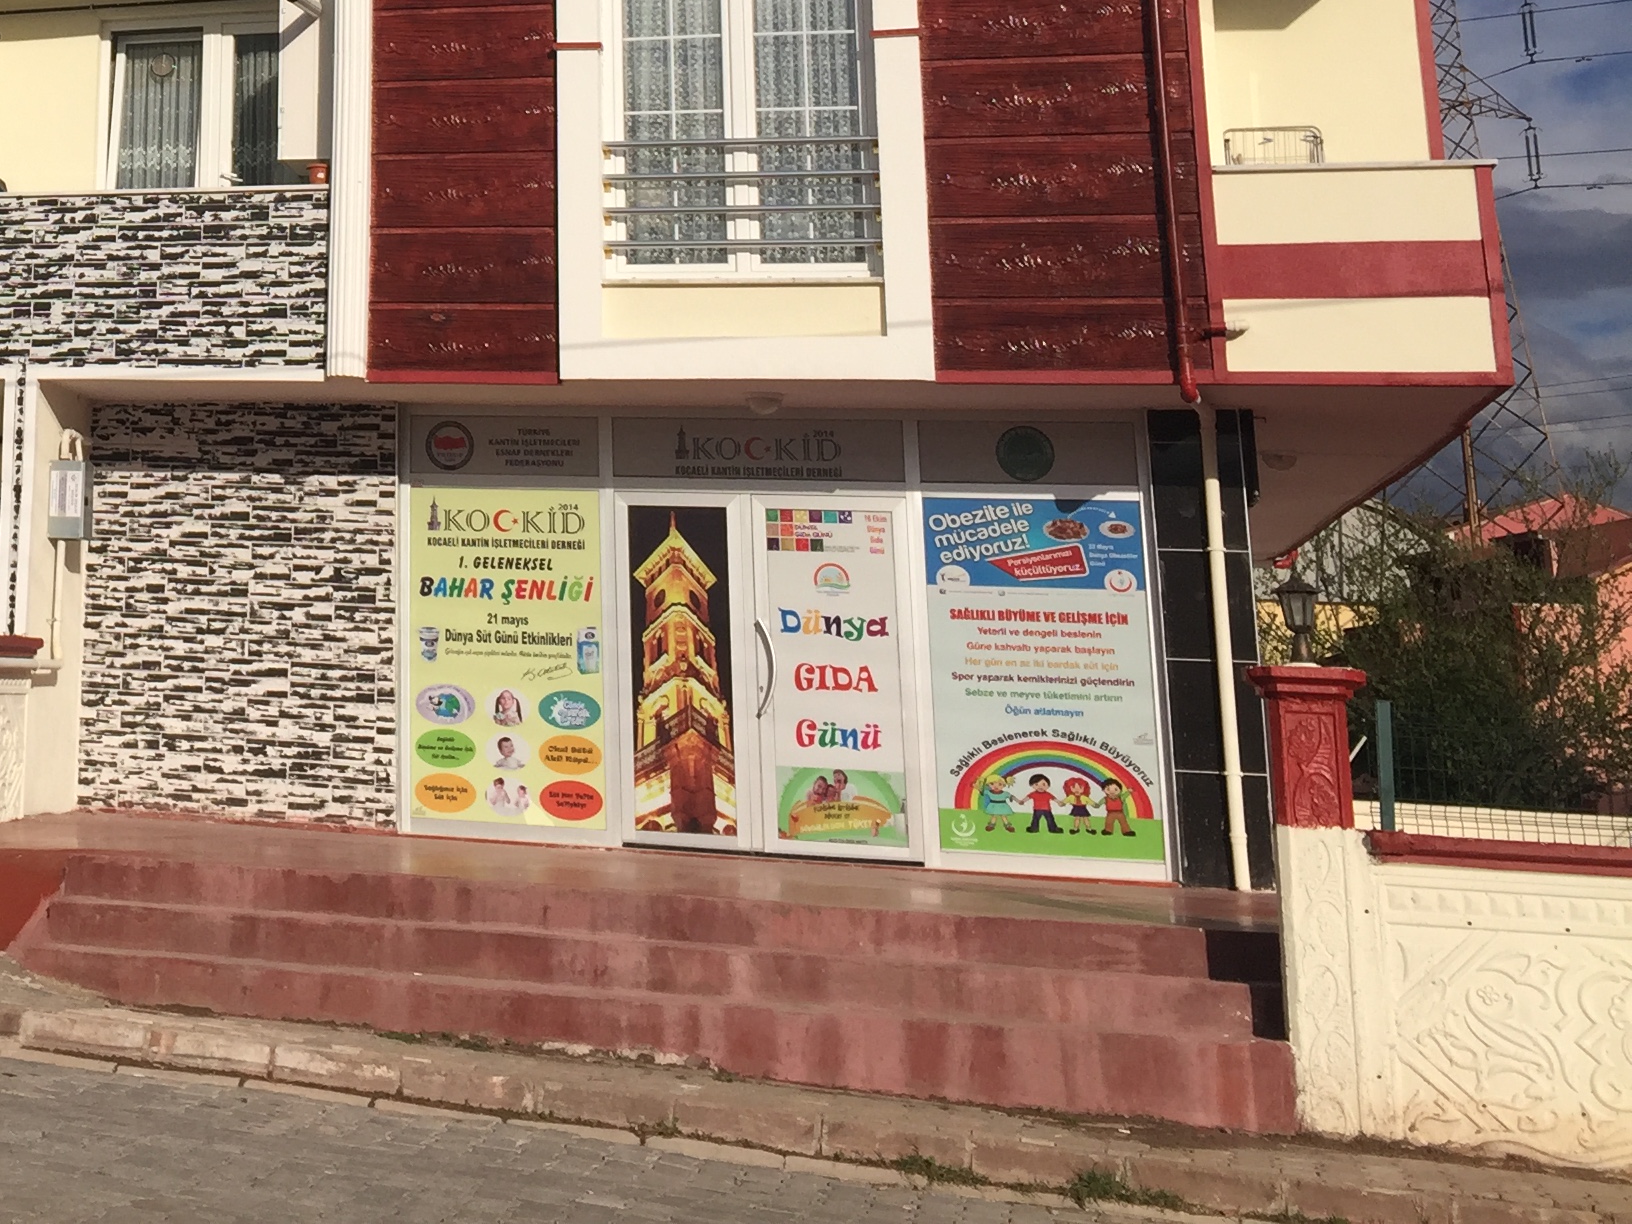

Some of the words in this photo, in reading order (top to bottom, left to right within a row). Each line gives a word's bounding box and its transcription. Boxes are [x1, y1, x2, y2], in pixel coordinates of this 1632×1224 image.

[812, 430, 834, 438] 2014
[675, 464, 709, 476] KOCAELİ
[711, 465, 741, 476] KANTİN
[806, 466, 843, 478] DERNEĞİ
[558, 503, 579, 511] 2014
[928, 503, 1010, 532] Obezite
[1012, 502, 1034, 516] ile
[934, 517, 1030, 548] mücadele
[427, 536, 460, 546] KOCAELİ
[461, 537, 490, 548] KANTİN
[491, 538, 549, 550] İŞLETMECİLERİ
[551, 538, 586, 550] DERNEĞİ
[940, 536, 1030, 564] ediyoruz!
[459, 556, 468, 569] 1.
[473, 556, 554, 571] GELENEKSEL
[419, 576, 494, 600] BAHAR
[500, 576, 594, 606] ŞENLİĞİ
[487, 612, 498, 625] 21
[501, 616, 530, 628] mayıs
[778, 607, 890, 642] Dünya
[950, 607, 996, 621] SAĞLIKLI
[998, 608, 1042, 622] BÜYÜME
[1043, 611, 1057, 623] VE
[1058, 610, 1104, 626] GELİŞME
[1105, 611, 1128, 626] İÇİN
[444, 628, 474, 646] Dünya
[476, 630, 492, 644] Süt
[494, 630, 518, 644] Günü
[521, 631, 573, 646] Etkinlikleri
[977, 626, 1006, 636] Yeterli
[1022, 628, 1058, 640] dengeli
[1060, 630, 1102, 639] beslenin
[966, 642, 993, 651] Güne
[1033, 644, 1072, 656] yaparak
[1074, 644, 1116, 656] başlayın
[964, 657, 982, 666] Her
[984, 659, 1004, 670] gün
[1047, 660, 1080, 670] bardak
[794, 662, 879, 693] GIDA
[952, 672, 974, 683] Spor
[976, 673, 1014, 684] yaparak
[1017, 674, 1078, 686] kemiklerinizi
[1080, 676, 1135, 690] güçlendirin
[964, 688, 994, 698] Sebze
[996, 690, 1008, 698] ve
[1010, 691, 1040, 702] meyve
[1042, 690, 1091, 701] tüketimini
[1004, 704, 1032, 717] Öğün
[1034, 706, 1084, 718] atlatmayın
[796, 718, 882, 752] Günü
[950, 746, 983, 778] Sağlıklı
[981, 728, 1048, 750] Beslenerek
[1051, 728, 1098, 748] Sağlıklı
[1100, 741, 1154, 788] Büyüyoruz
